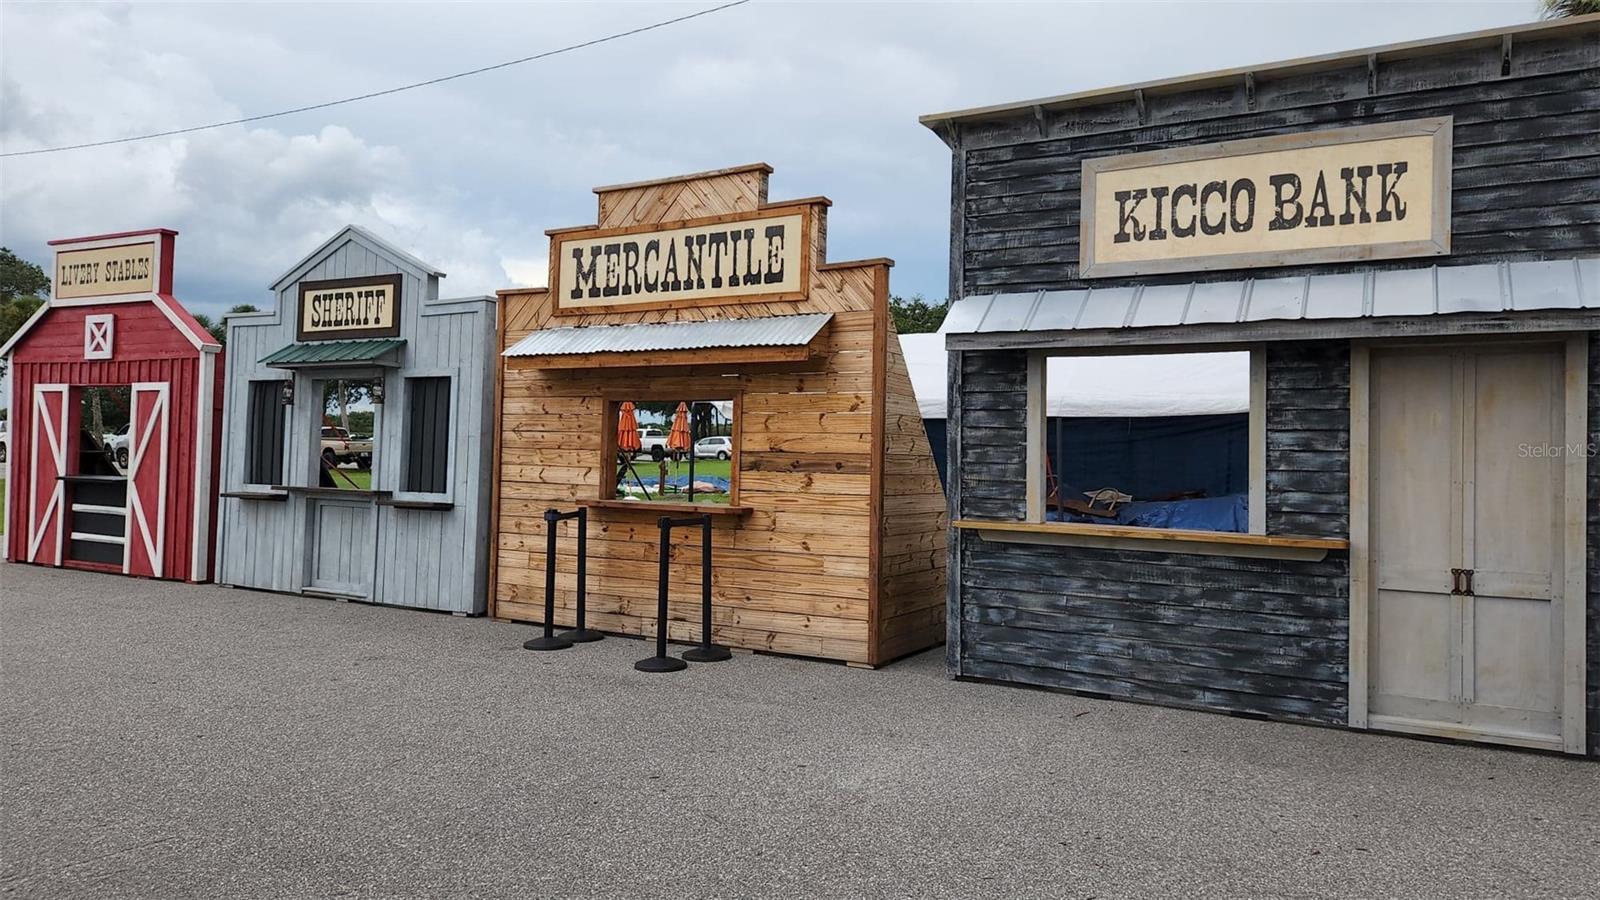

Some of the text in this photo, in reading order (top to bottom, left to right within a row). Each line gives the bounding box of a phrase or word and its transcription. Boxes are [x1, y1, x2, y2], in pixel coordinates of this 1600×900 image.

[1113, 161, 1408, 243] KICCO BANK
[61, 258, 149, 285] LIVERY STABLES
[571, 225, 784, 299] MERCANTILE
[311, 289, 386, 328] SHERIFF
